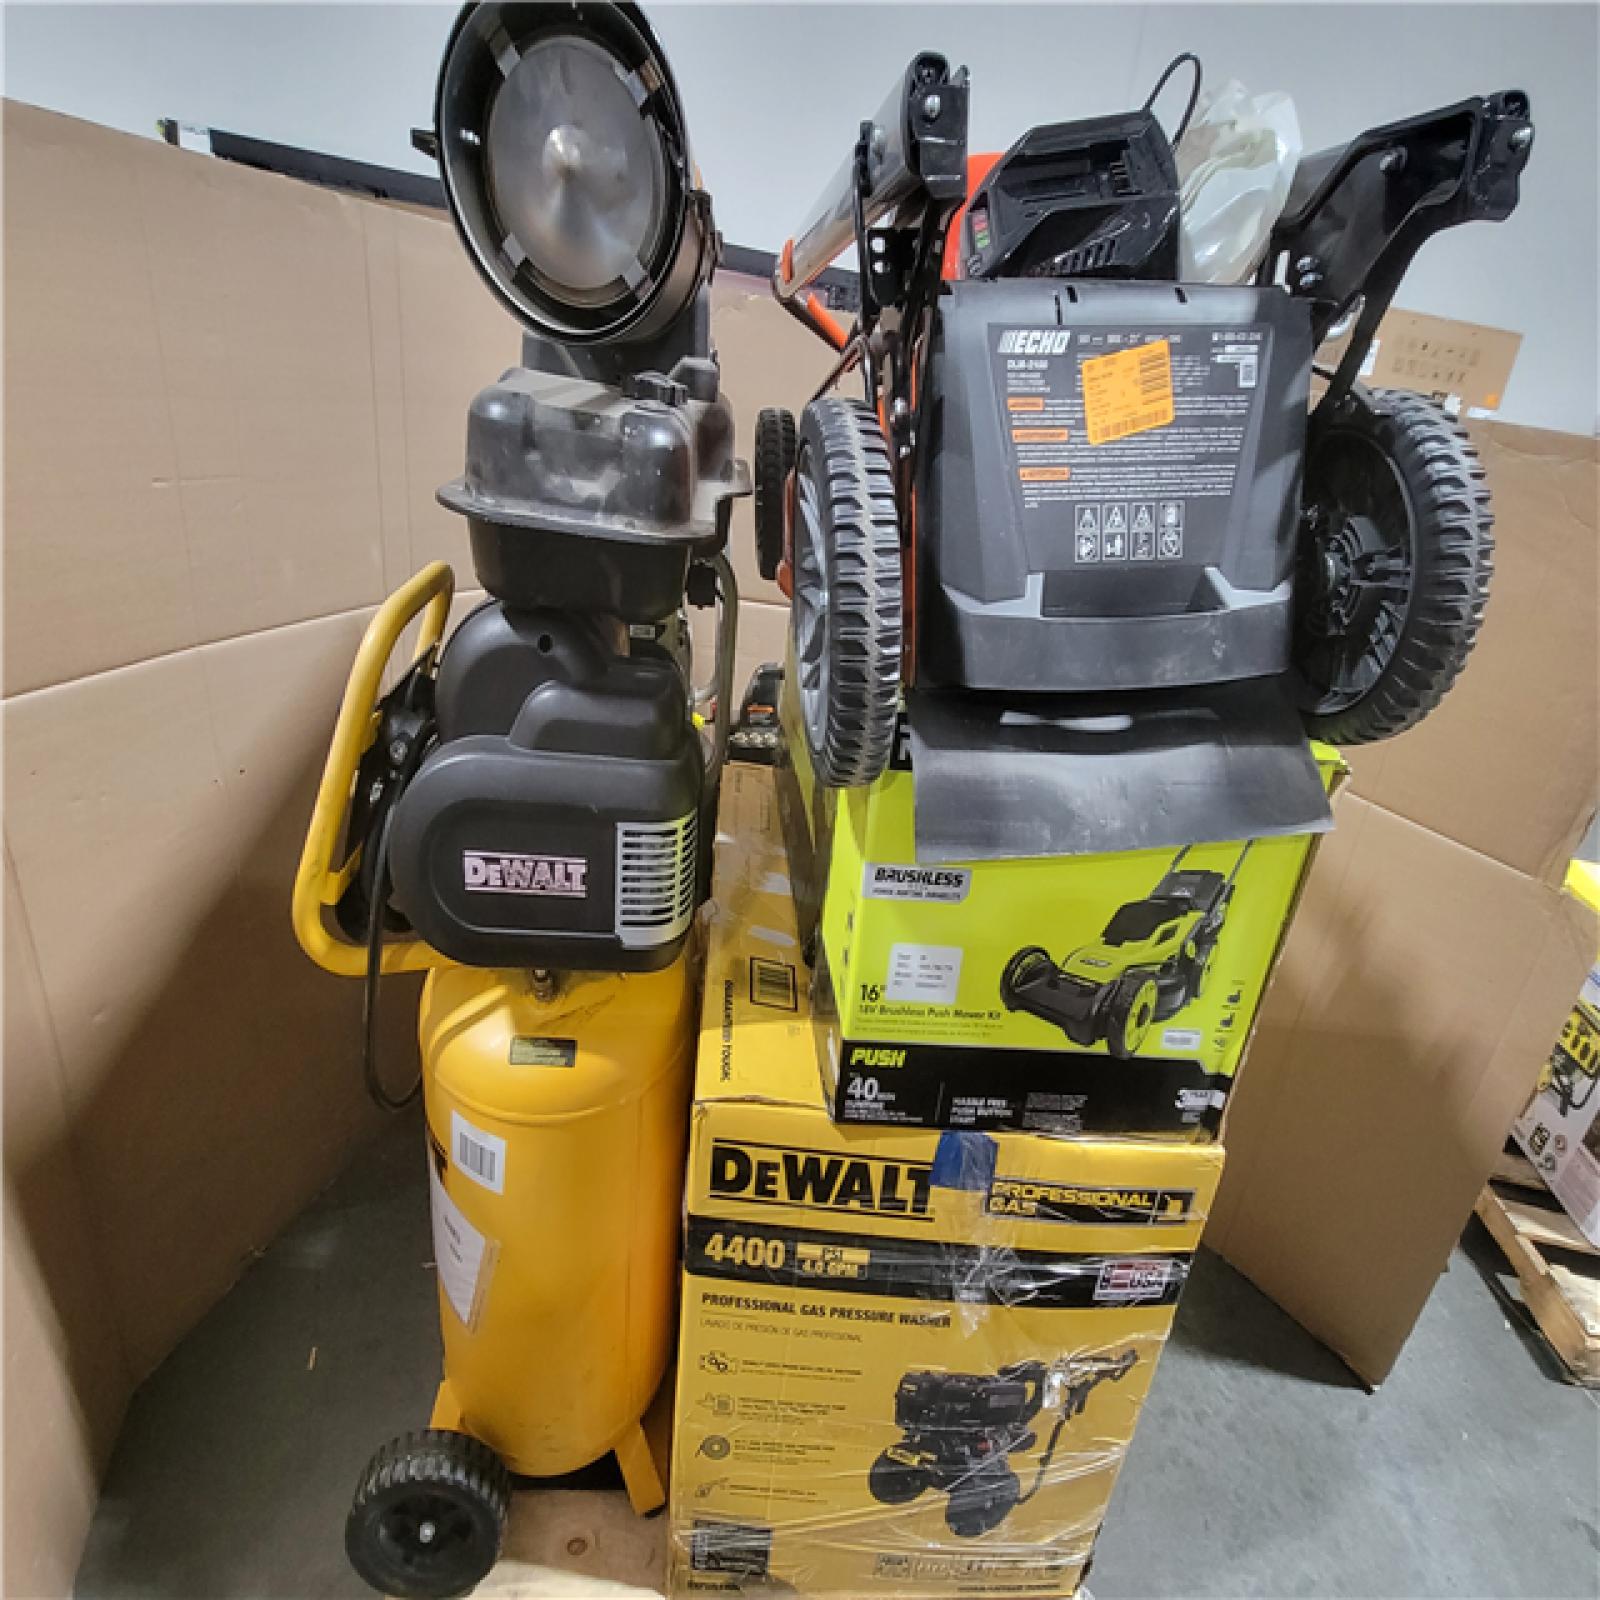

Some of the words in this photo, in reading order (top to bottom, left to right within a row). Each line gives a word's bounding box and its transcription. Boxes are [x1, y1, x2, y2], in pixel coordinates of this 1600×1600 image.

[1013, 329, 1071, 354] ECHO
[464, 855, 587, 892] DEWALT
[874, 867, 964, 888] BRUSHLESS
[849, 1049, 906, 1068] PUSH
[847, 1077, 879, 1101] 40
[989, 1196, 1038, 1216] GAS
[990, 1181, 1153, 1207] PROFESSIONAL
[703, 1232, 786, 1270] 4400
[701, 1292, 796, 1315] PROFESSIONAL
[799, 1304, 826, 1317] GAS
[829, 1307, 896, 1323] PRESSURE
[899, 1312, 952, 1329] WASHER
